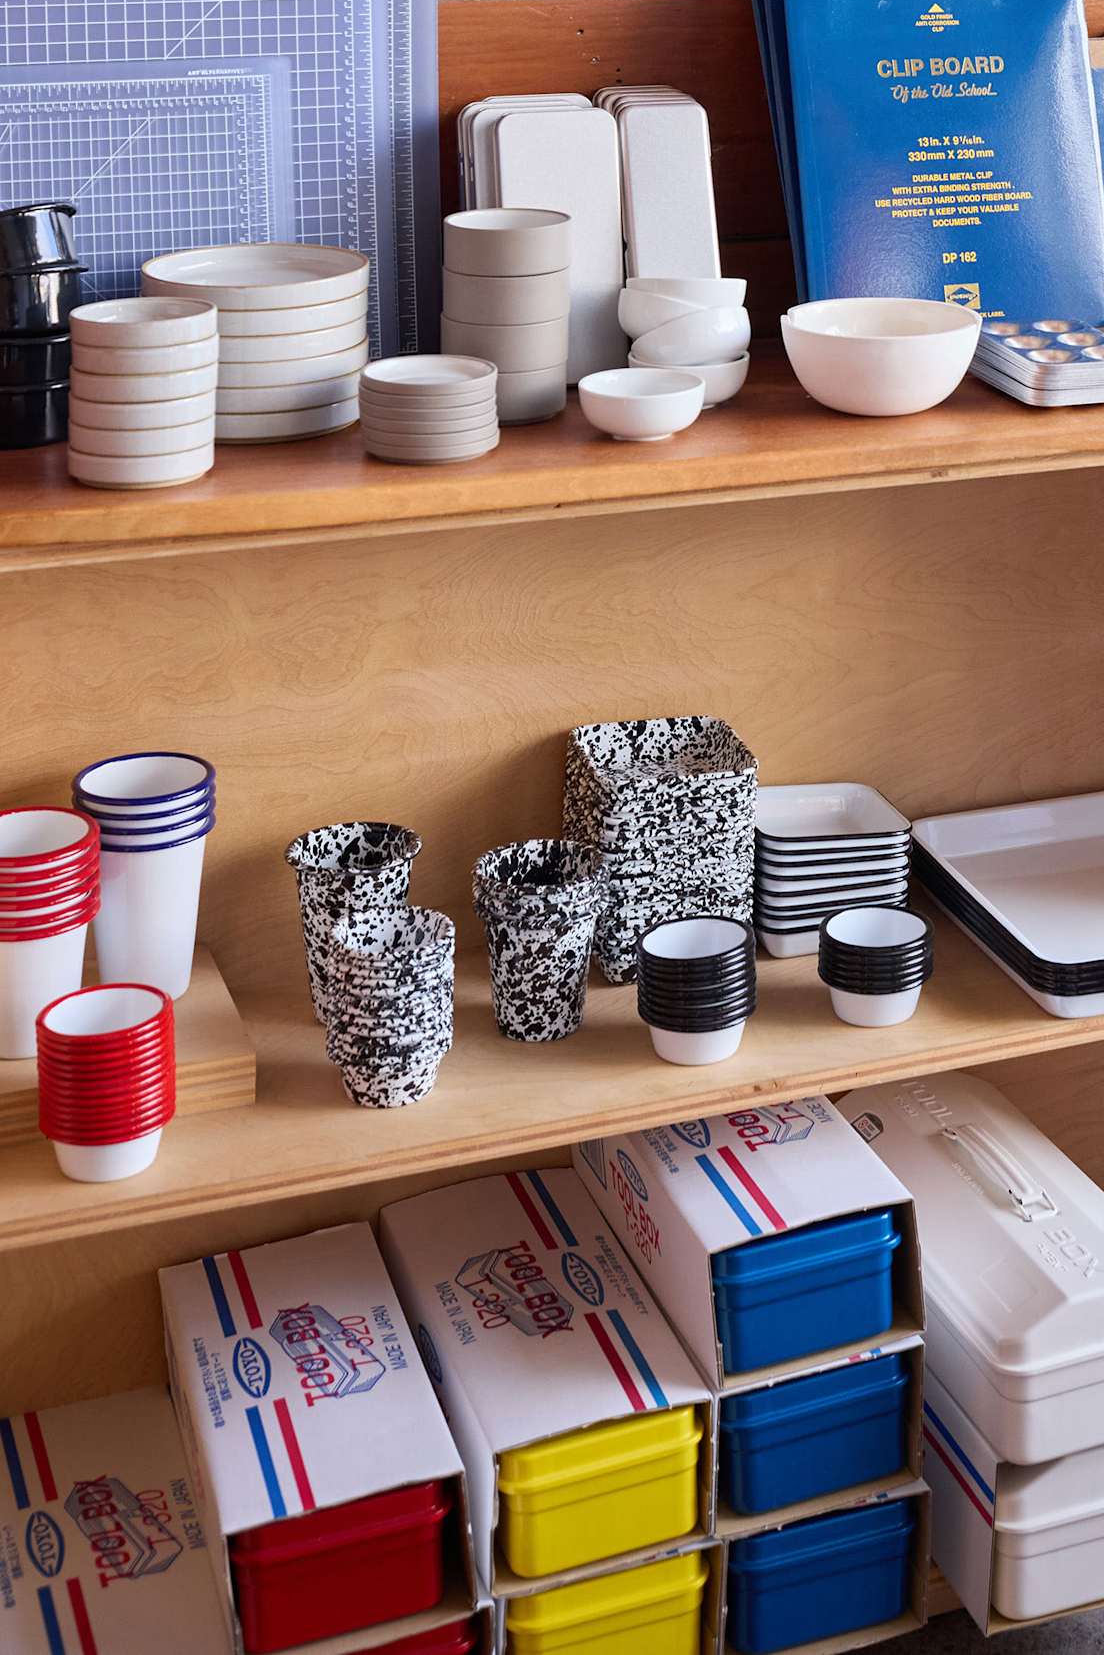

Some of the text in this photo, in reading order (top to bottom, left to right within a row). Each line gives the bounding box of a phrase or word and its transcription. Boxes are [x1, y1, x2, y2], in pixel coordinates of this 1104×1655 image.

[876, 55, 1005, 78] CLIP BOARD
[890, 81, 998, 103] Of the Old School
[943, 137, 951, 145] X
[947, 150, 955, 159] X
[912, 171, 993, 183] DURABLE METAL CLIP
[875, 200, 891, 208] USE
[892, 197, 933, 207] RECYCLED
[933, 196, 956, 205] HARD
[957, 195, 981, 204] WOOD
[982, 193, 1004, 202] FIBER
[892, 187, 912, 195] WITH
[913, 185, 938, 194] EXTRA
[892, 209, 928, 218] PROTECT
[935, 207, 956, 216] KEEP
[957, 205, 979, 215] YOUR
[979, 203, 1020, 213] VALUABLE
[942, 251, 977, 264] DP 162
[499, 1241, 574, 1339] TOOL BOX
[570, 1262, 597, 1295] TOYO
[434, 1280, 455, 1307] MADE
[451, 1317, 477, 1346] JAPAN
[370, 1305, 409, 1371] MADE IN JAPAN
[278, 1302, 341, 1407] TOOL BOX
[239, 1348, 263, 1387] TOYO
[74, 1474, 134, 1589] TOOL BOX
[32, 1522, 56, 1565] TOYO
